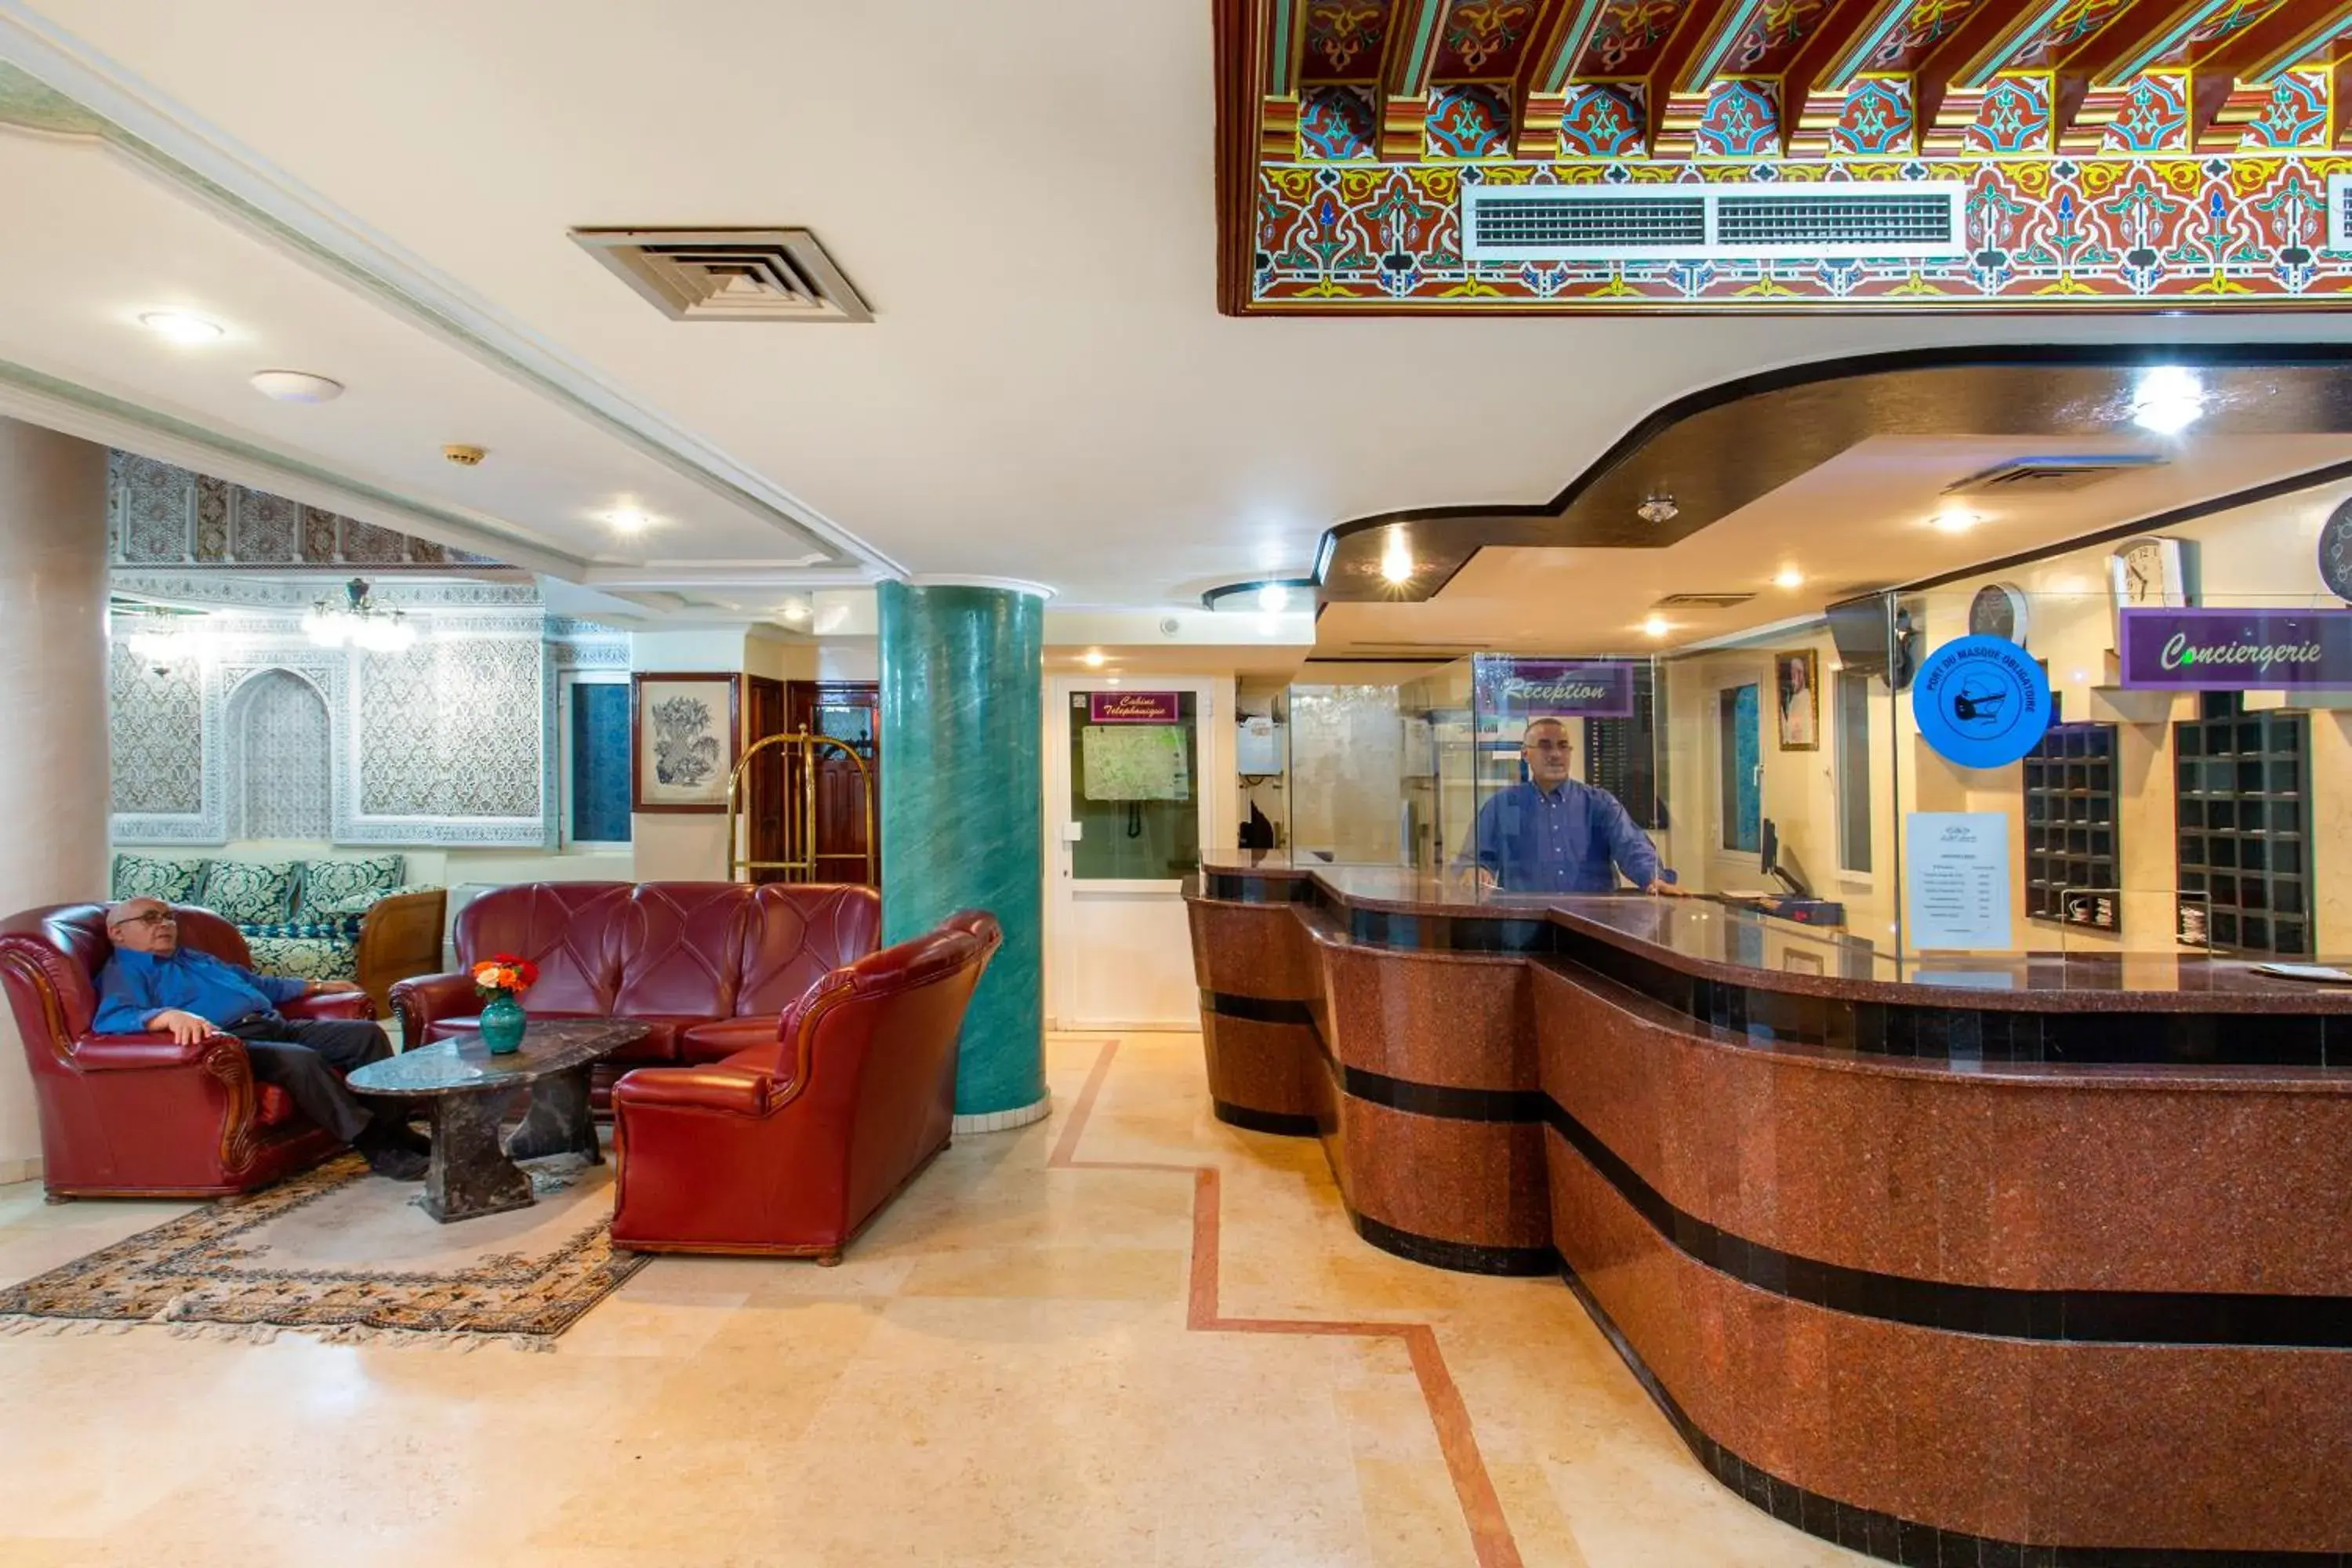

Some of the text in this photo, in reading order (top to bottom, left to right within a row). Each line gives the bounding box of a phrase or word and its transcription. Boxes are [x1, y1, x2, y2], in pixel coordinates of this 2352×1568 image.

[1926, 666, 1944, 691] PORT
[1941, 654, 1957, 667] DU
[1958, 646, 2001, 660] MASQUE
[2160, 632, 2322, 673] Conciergerie
